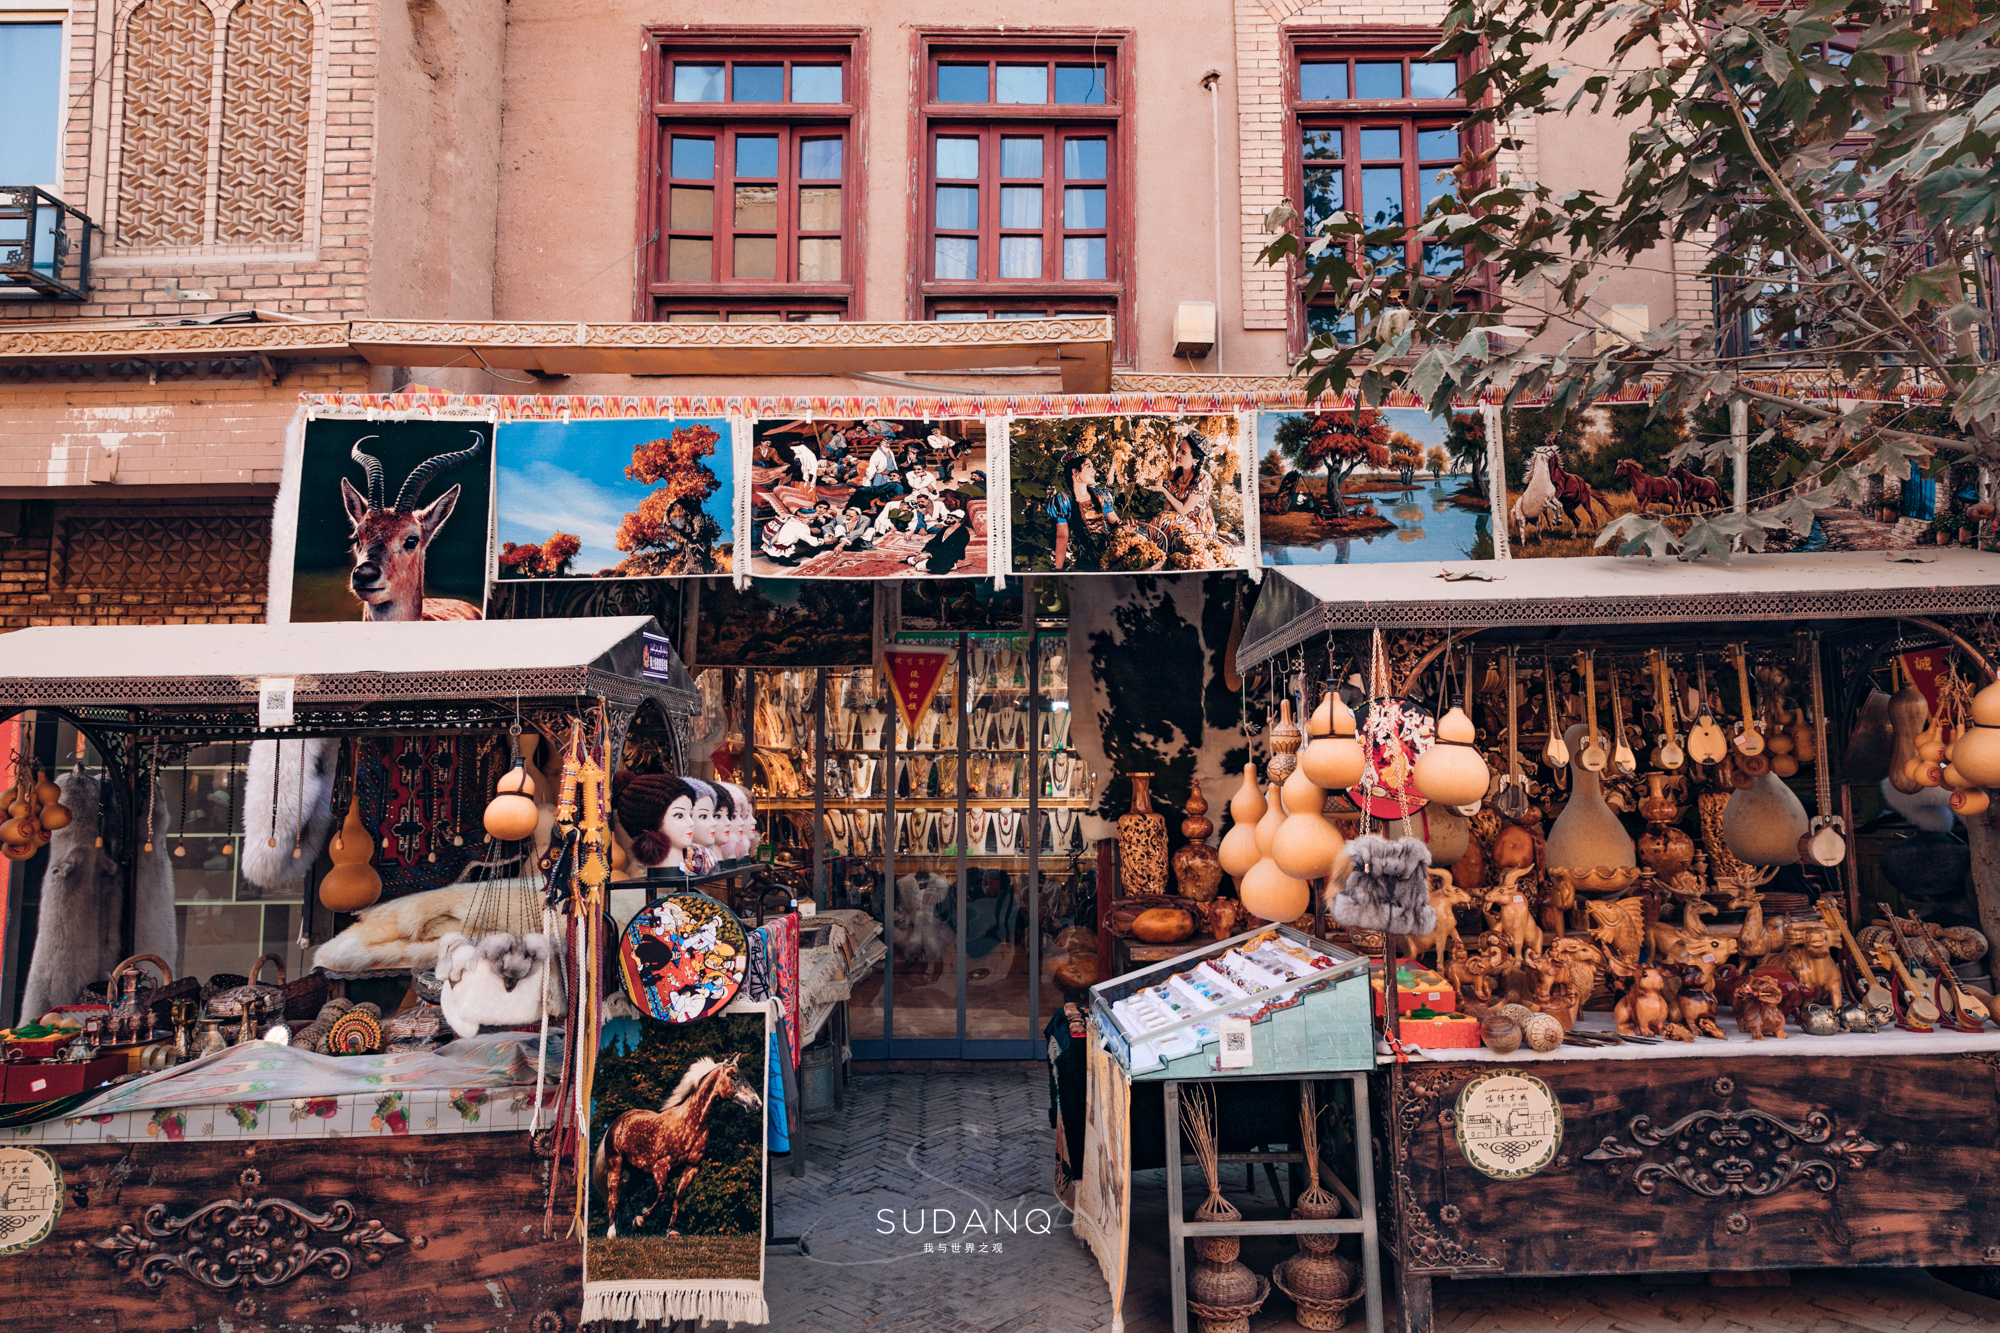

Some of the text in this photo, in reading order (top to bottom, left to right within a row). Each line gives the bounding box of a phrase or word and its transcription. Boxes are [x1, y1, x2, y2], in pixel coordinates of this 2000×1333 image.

[906, 670, 920, 711] 流动红旗
[1485, 1093, 1528, 1102] 喀什古城
